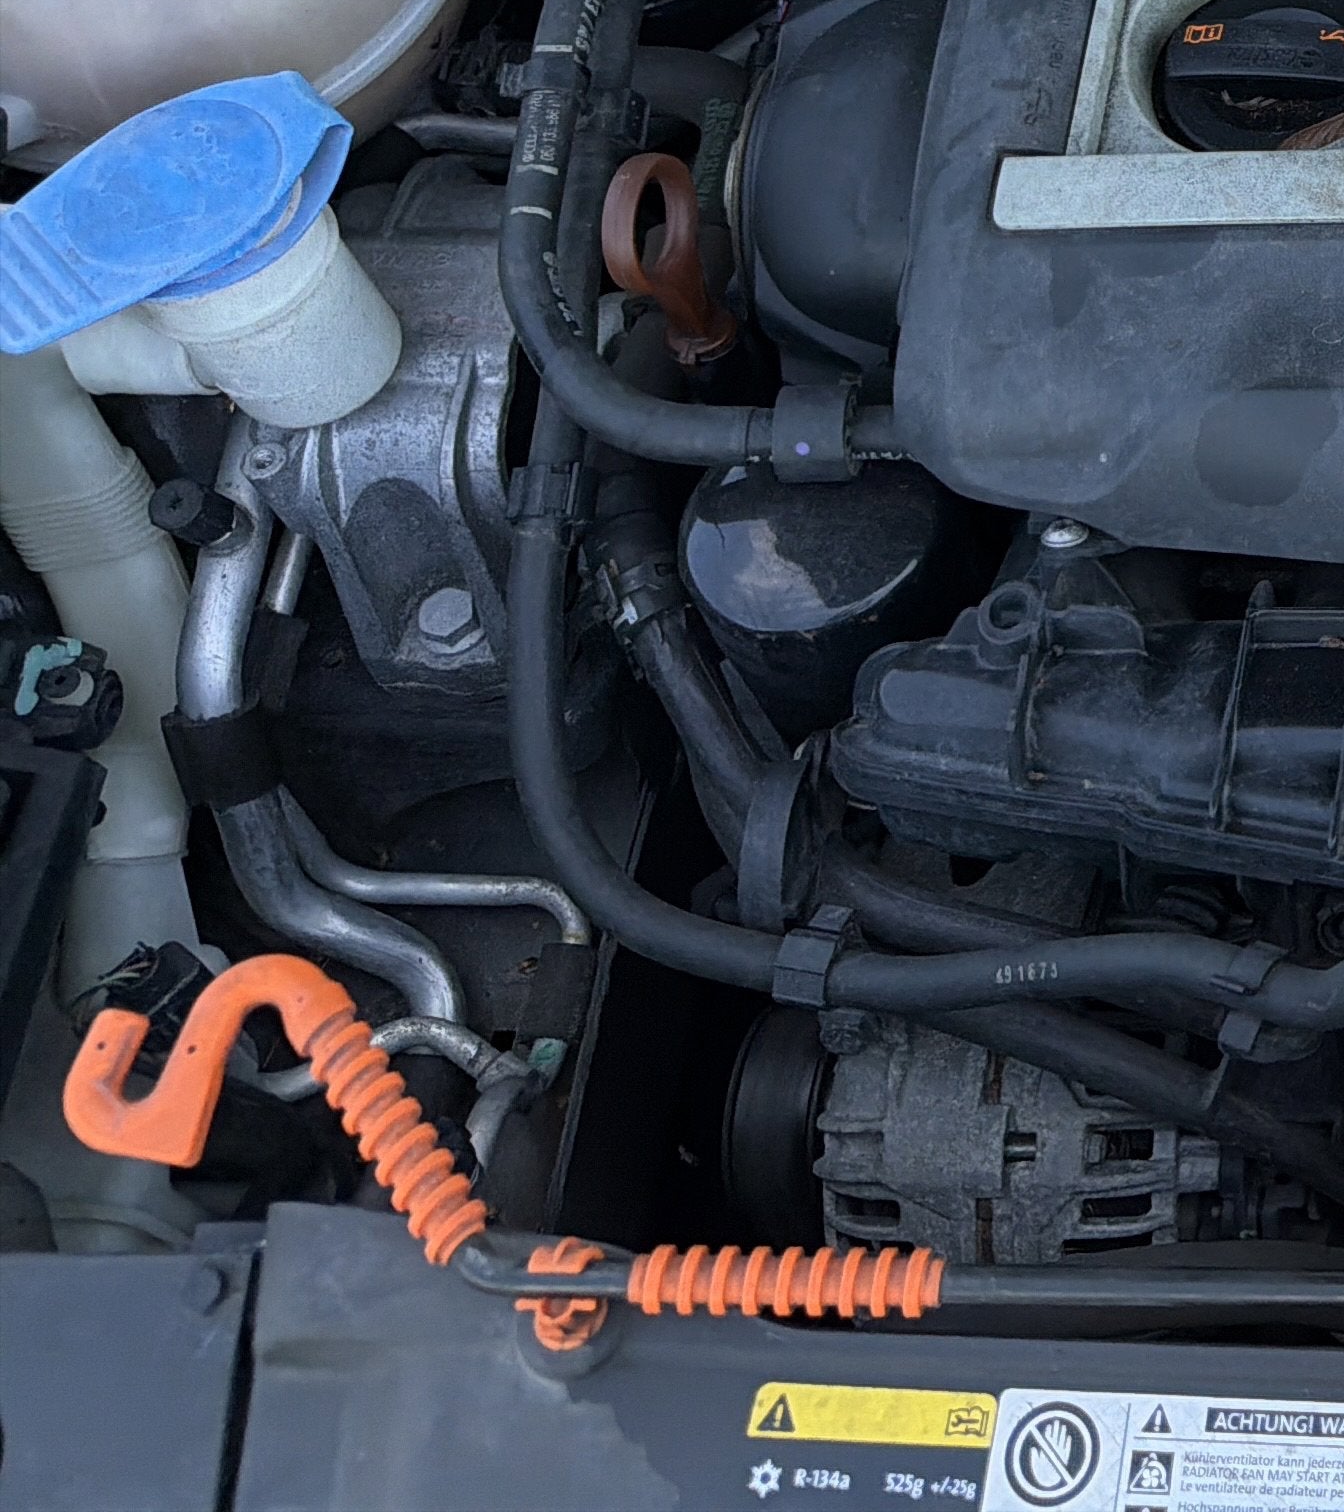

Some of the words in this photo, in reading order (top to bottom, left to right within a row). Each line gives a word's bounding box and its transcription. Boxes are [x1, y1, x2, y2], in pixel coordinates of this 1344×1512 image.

[1214, 1412, 1316, 1434] ACHTUNG!
[1184, 1451, 1274, 1467] Kühlerventilator
[1278, 1455, 1305, 1468] kann
[1182, 1466, 1239, 1480] RADIATOR
[1268, 1469, 1294, 1482] MAY
[1296, 1470, 1330, 1483] START
[793, 1468, 850, 1490] R-134a
[885, 1472, 924, 1499] 525g
[1180, 1481, 1193, 1492] Le
[1195, 1481, 1257, 1494] ventilateur
[1259, 1483, 1273, 1495] de
[1276, 1485, 1328, 1497] radiateur
